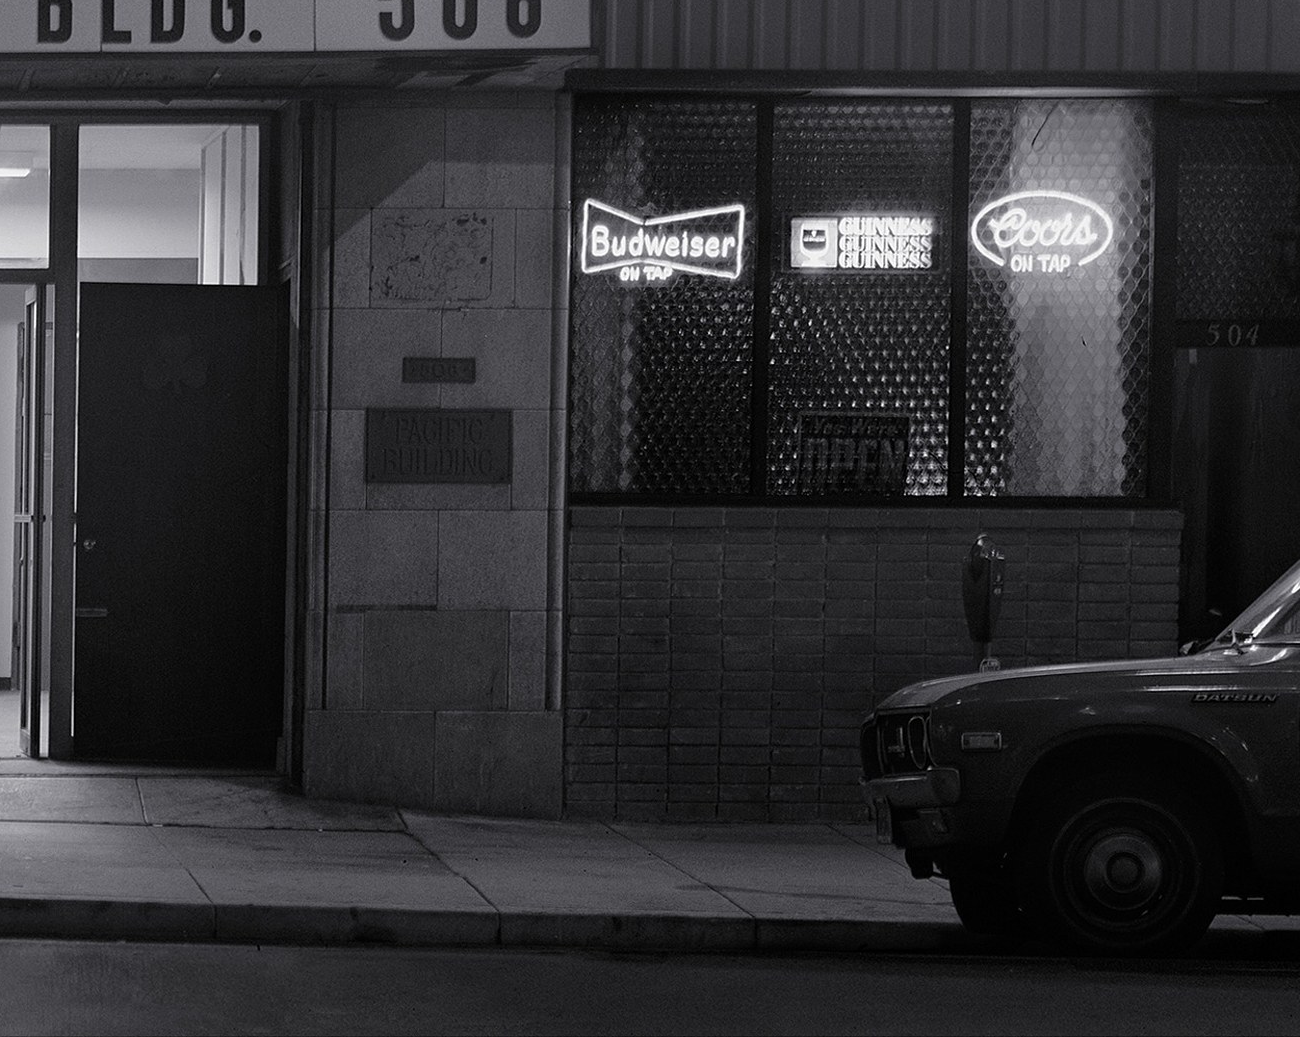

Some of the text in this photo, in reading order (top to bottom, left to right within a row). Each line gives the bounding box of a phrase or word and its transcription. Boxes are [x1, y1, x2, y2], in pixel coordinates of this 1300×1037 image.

[838, 216, 934, 236] GUINNESS
[988, 207, 1098, 248] Coors
[591, 225, 736, 258] Budweiser
[838, 235, 933, 252] GUINNESS
[838, 251, 933, 269] GUINNESS
[1010, 254, 1071, 273] ON TAP
[619, 266, 674, 281] ON TAP
[1206, 322, 1260, 347] 504
[395, 417, 483, 445] PACIFIC
[383, 448, 493, 476] BUILDING
[1191, 694, 1277, 703] DATSUN
